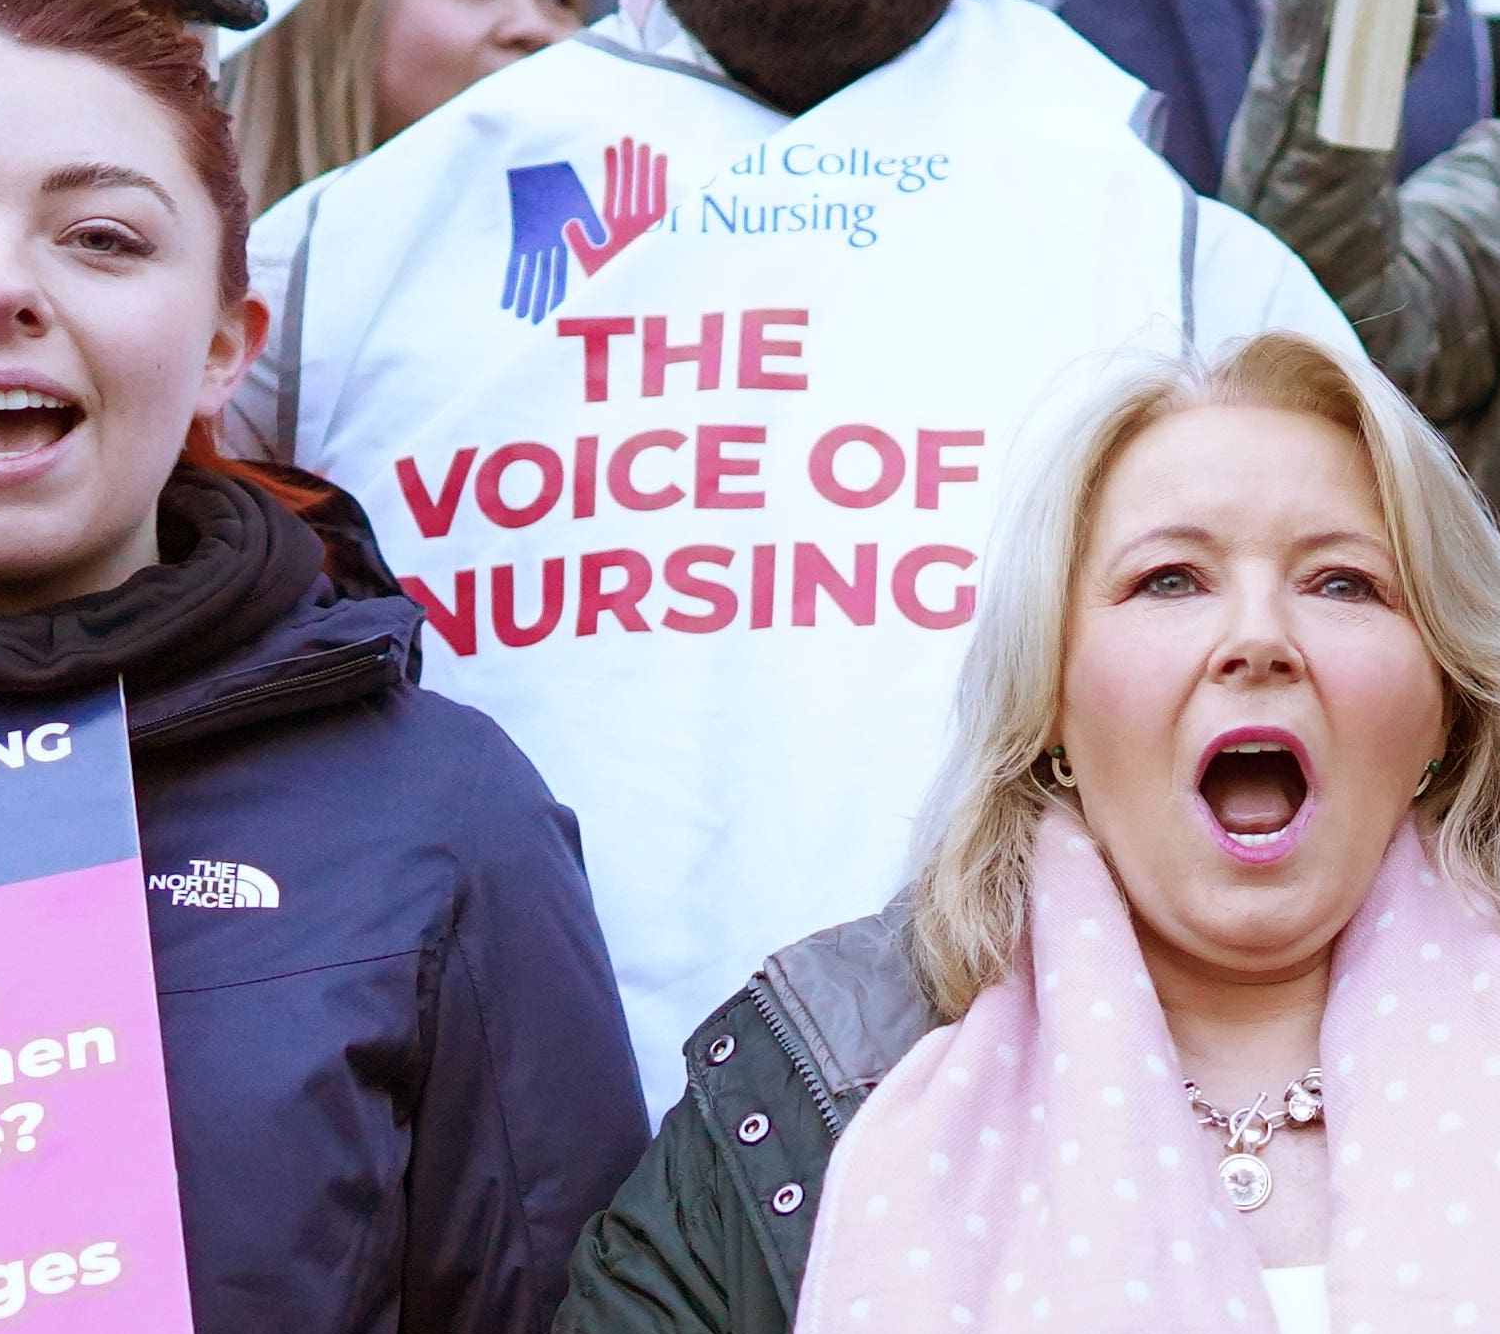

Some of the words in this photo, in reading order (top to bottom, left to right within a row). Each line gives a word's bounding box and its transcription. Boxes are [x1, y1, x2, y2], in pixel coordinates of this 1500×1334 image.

[782, 144, 950, 193] College
[701, 193, 878, 248] Nursing
[557, 309, 809, 403] THE
[394, 425, 767, 539] VOICE
[809, 423, 986, 511] OF
[398, 543, 979, 658] NURSING
[148, 874, 236, 894] NORTH
[189, 860, 237, 879] THE
[172, 890, 234, 908] FACE
